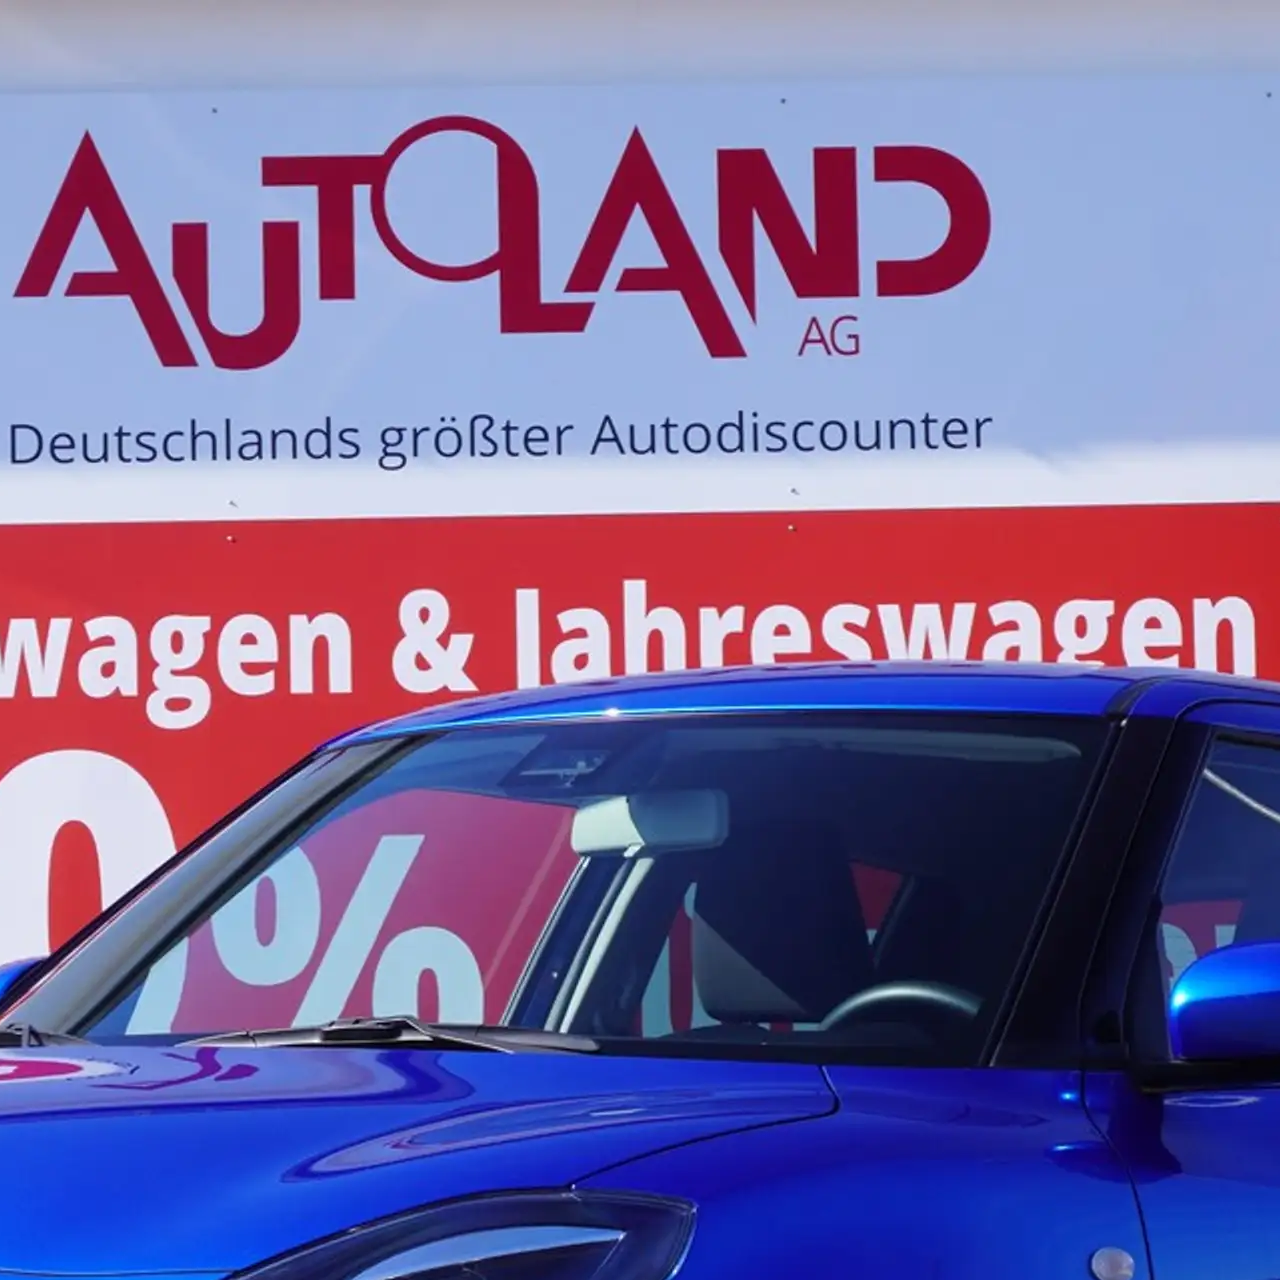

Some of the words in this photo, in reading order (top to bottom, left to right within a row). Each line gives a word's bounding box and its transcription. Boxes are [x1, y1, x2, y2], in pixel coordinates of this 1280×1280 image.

[798, 315, 860, 356] AG
[8, 415, 362, 465] Deutschlands
[378, 412, 575, 471] größter
[589, 409, 994, 457] Autodiscounter
[392, 587, 480, 693] &
